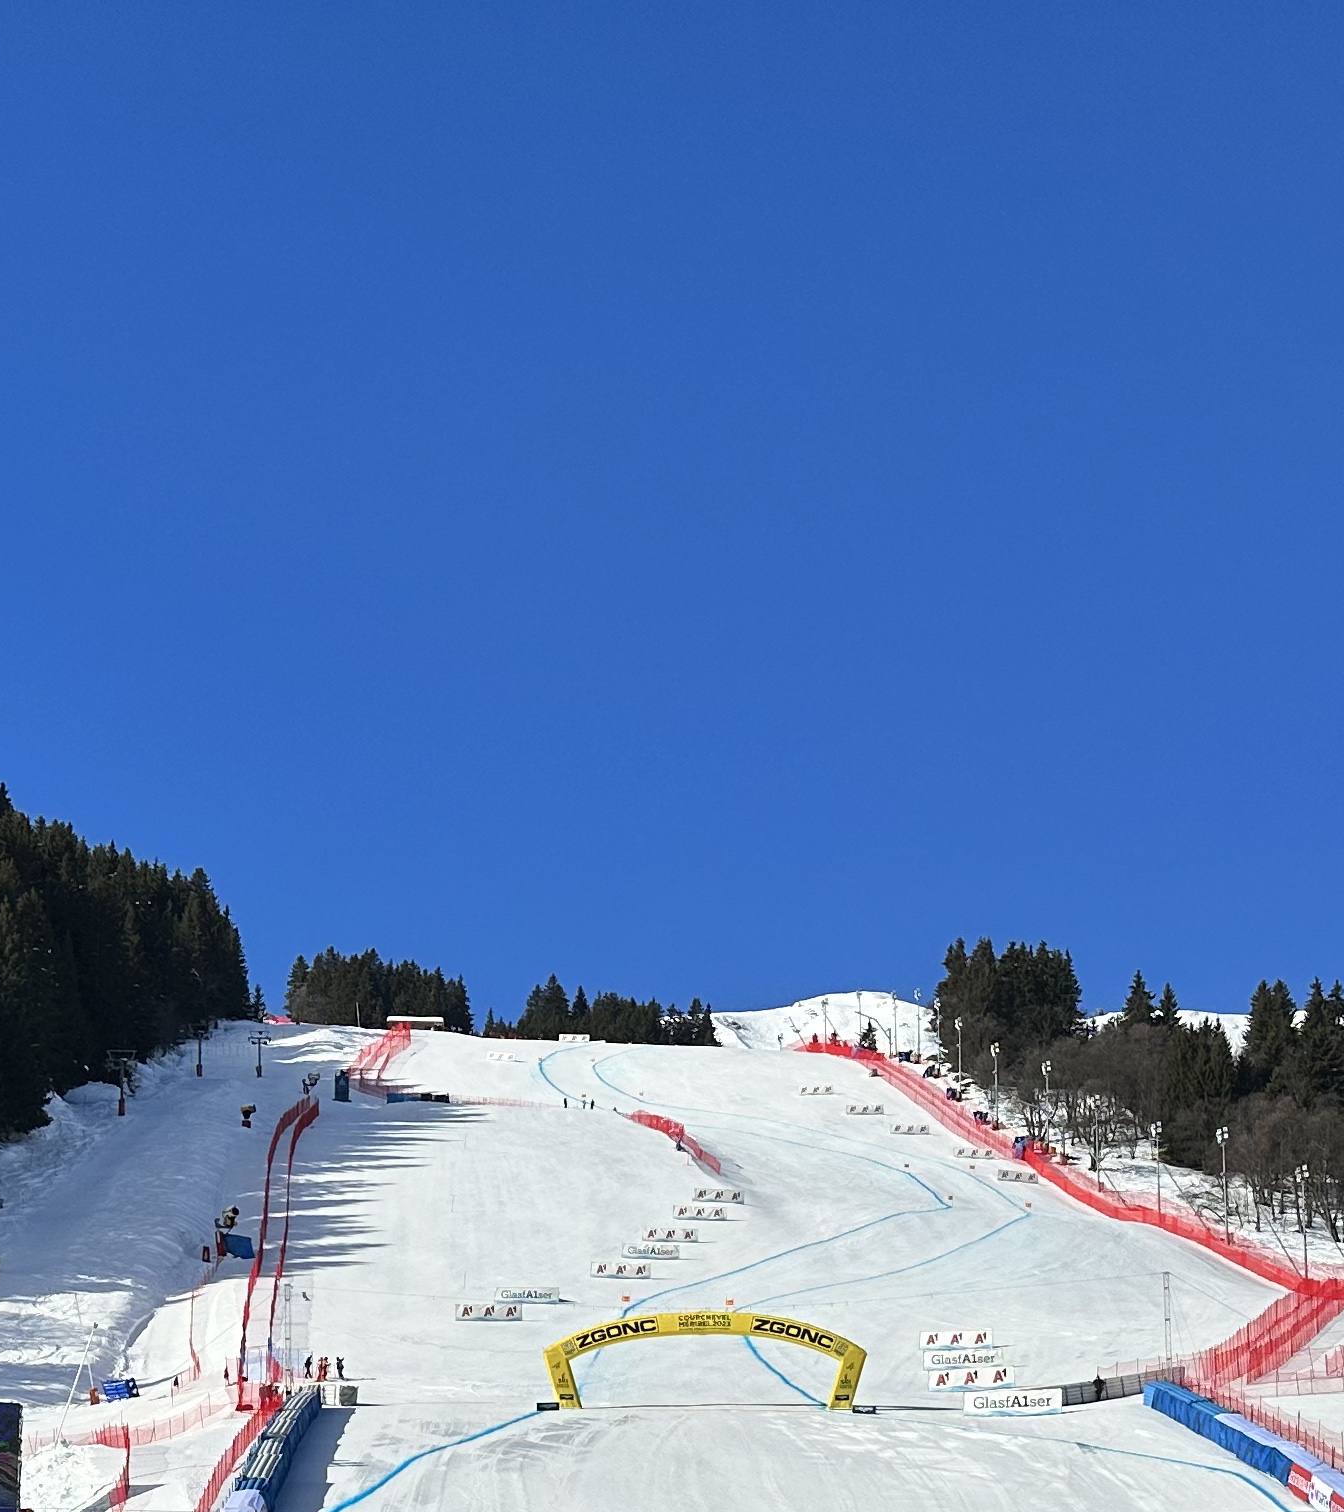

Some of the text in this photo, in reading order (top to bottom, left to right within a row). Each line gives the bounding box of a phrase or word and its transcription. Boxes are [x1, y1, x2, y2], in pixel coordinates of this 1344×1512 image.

[596, 1264, 646, 1275] A1 A1 A1
[462, 1305, 517, 1317] A1 A1 A1
[576, 1319, 657, 1349] ZGONC
[754, 1319, 834, 1349] ZGONC
[927, 1332, 987, 1345] A1 A1 A1
[931, 1354, 995, 1365] GlasfA1ser
[936, 1368, 1006, 1386] A1 A1 A1
[973, 1395, 1052, 1409] GlasfA1ser
